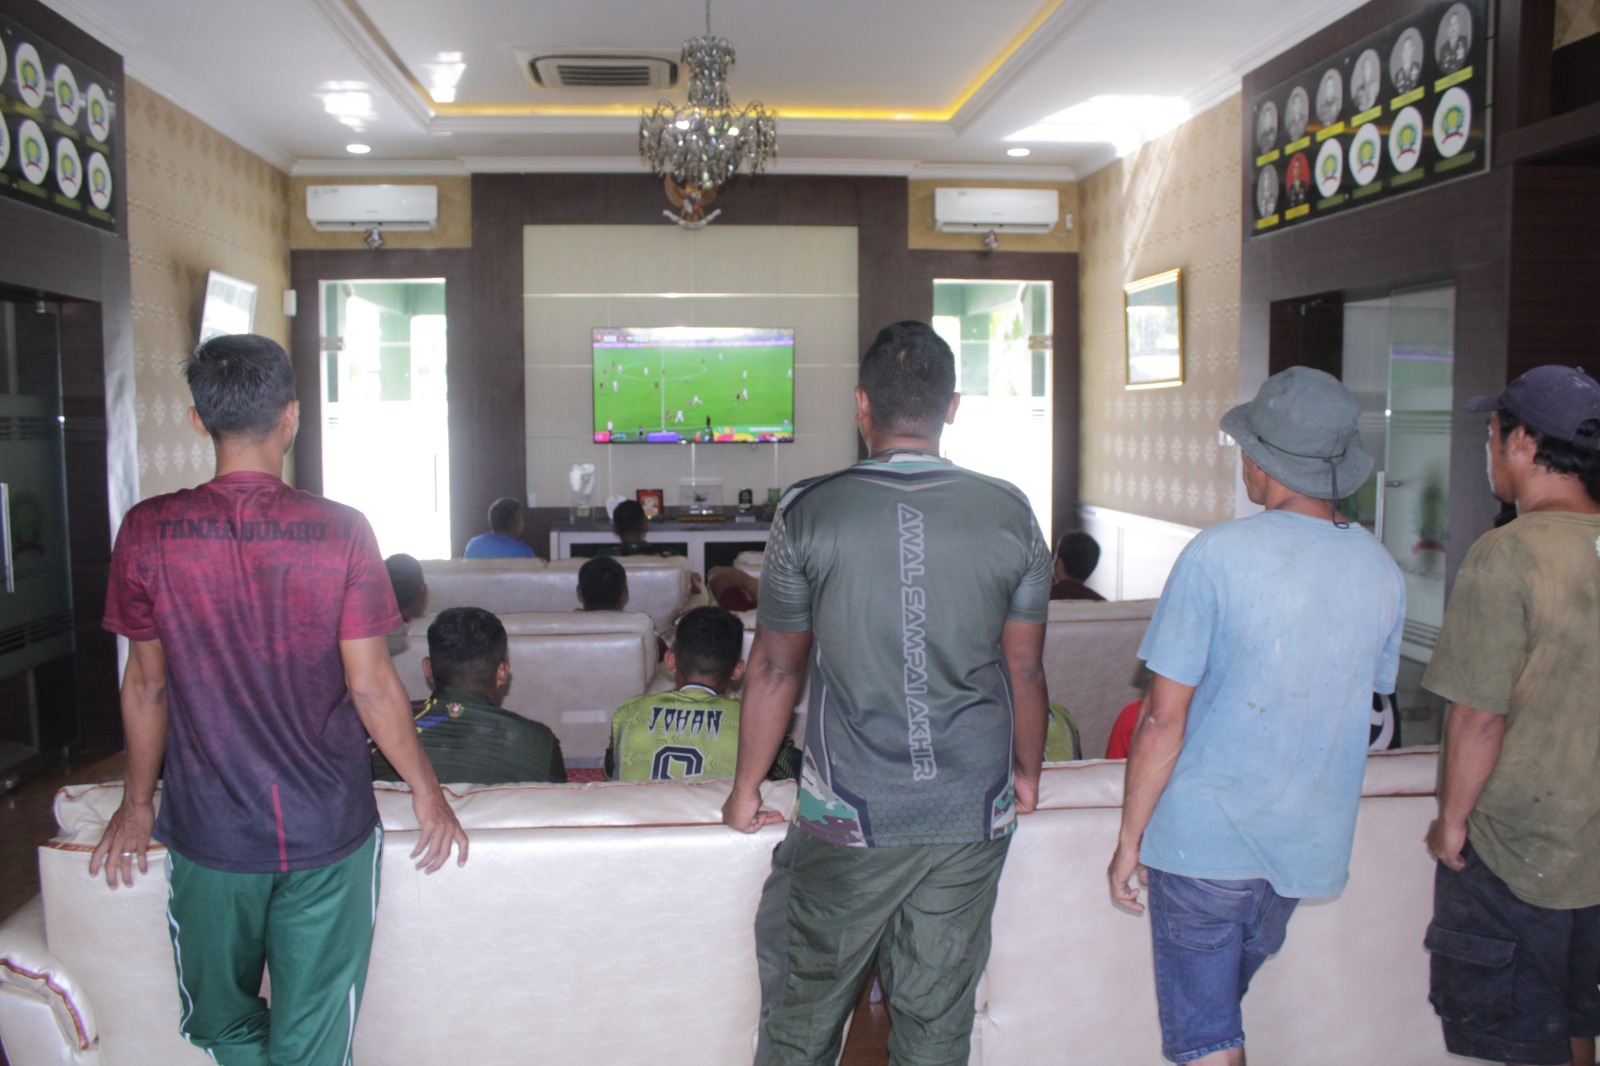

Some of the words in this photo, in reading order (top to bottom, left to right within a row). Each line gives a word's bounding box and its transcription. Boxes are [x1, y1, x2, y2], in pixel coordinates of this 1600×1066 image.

[897, 502, 925, 585] AWAL
[901, 586, 928, 695] SAMPAI
[648, 706, 724, 741] JOHAN
[905, 696, 937, 781] AKHIR
